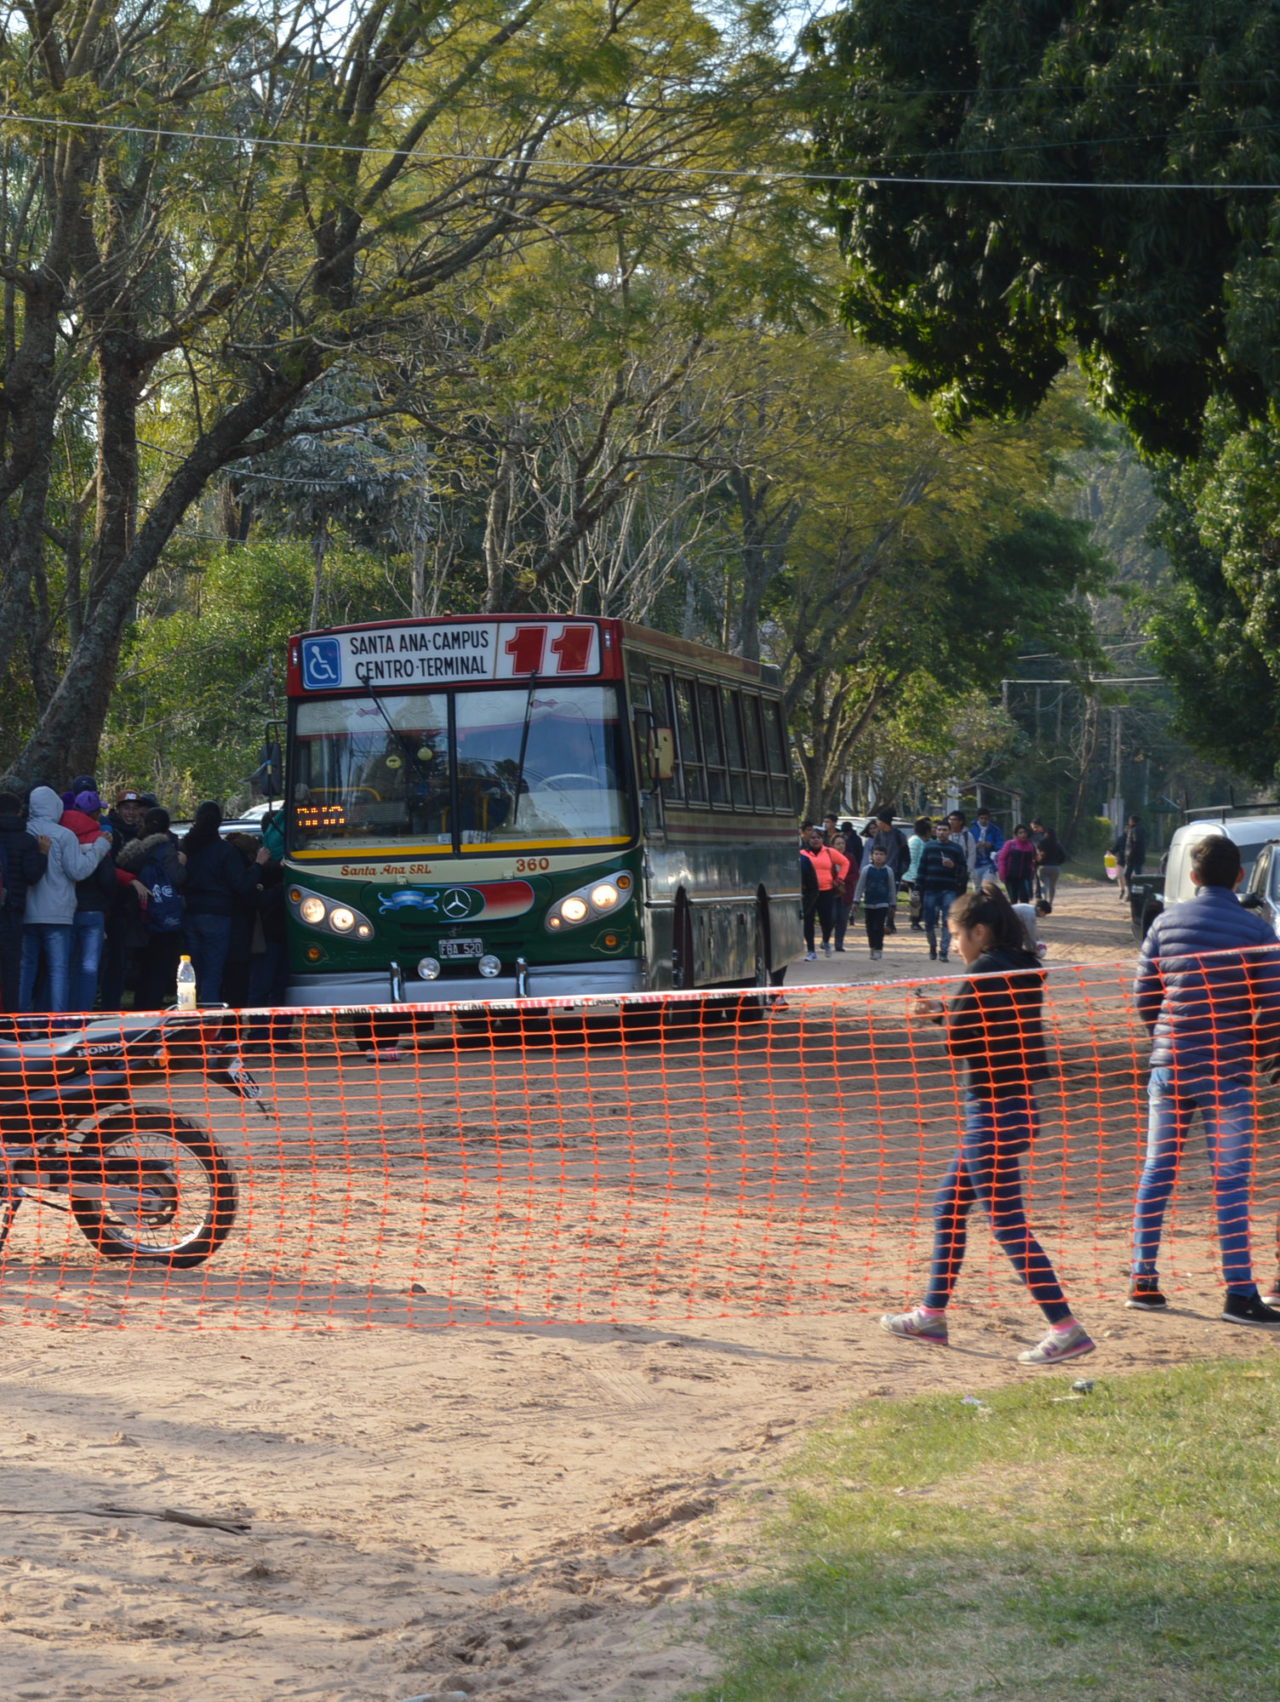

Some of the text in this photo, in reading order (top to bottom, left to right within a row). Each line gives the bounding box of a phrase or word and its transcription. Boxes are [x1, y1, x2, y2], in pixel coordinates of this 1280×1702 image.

[350, 635, 395, 655] SANTA
[505, 626, 594, 675] 11
[341, 864, 432, 876] Santa Ana SRL
[515, 857, 550, 873] 360
[76, 1041, 127, 1057] HOND
